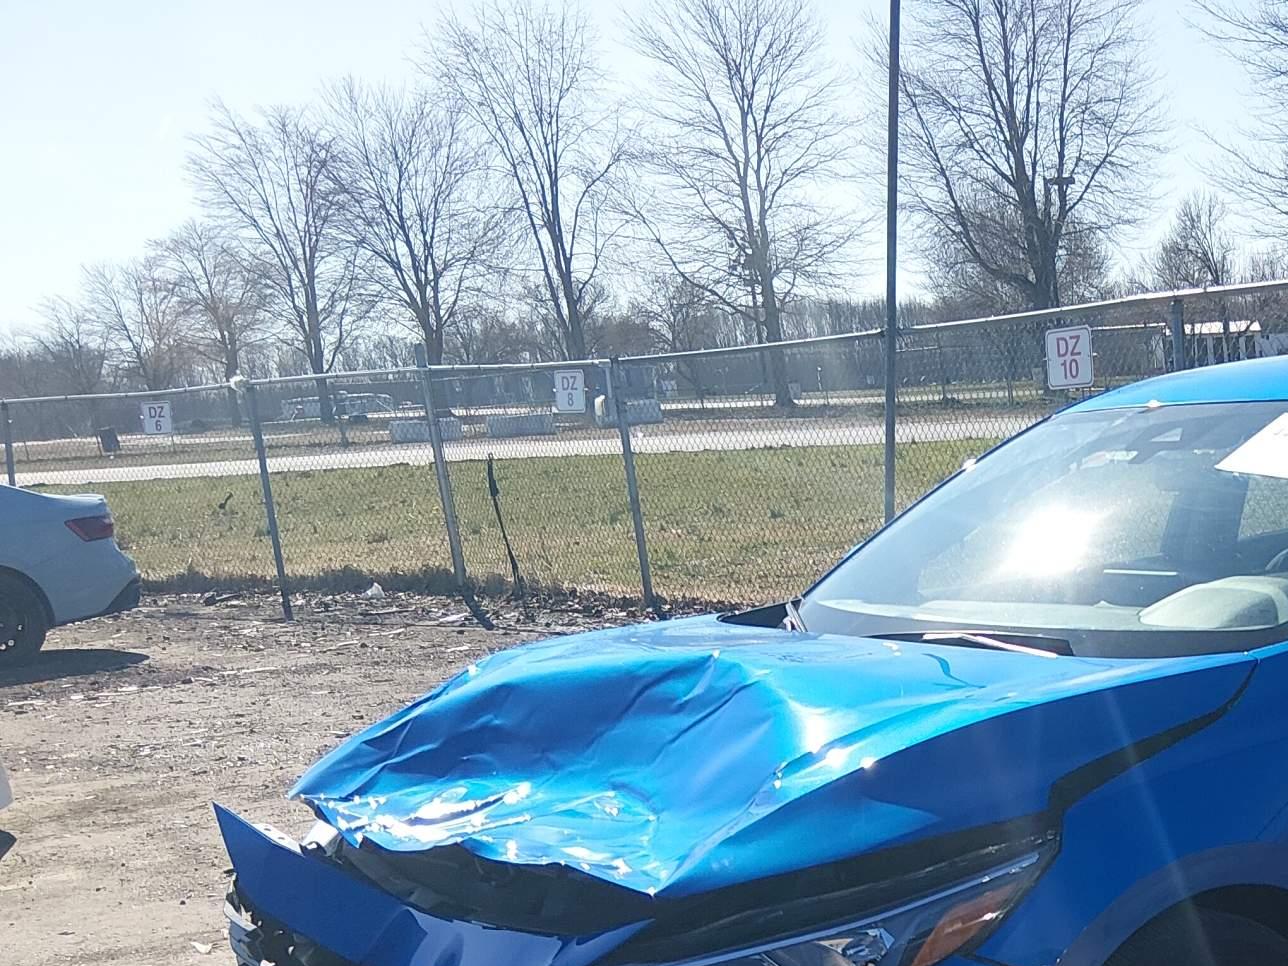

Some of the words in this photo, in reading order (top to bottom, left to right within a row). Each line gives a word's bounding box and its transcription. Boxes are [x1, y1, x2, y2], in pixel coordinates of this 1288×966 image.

[1055, 334, 1082, 357] DZ
[1060, 358, 1080, 380] 10
[561, 375, 578, 391] DZ
[567, 392, 574, 407] 8
[148, 405, 166, 419] DZ
